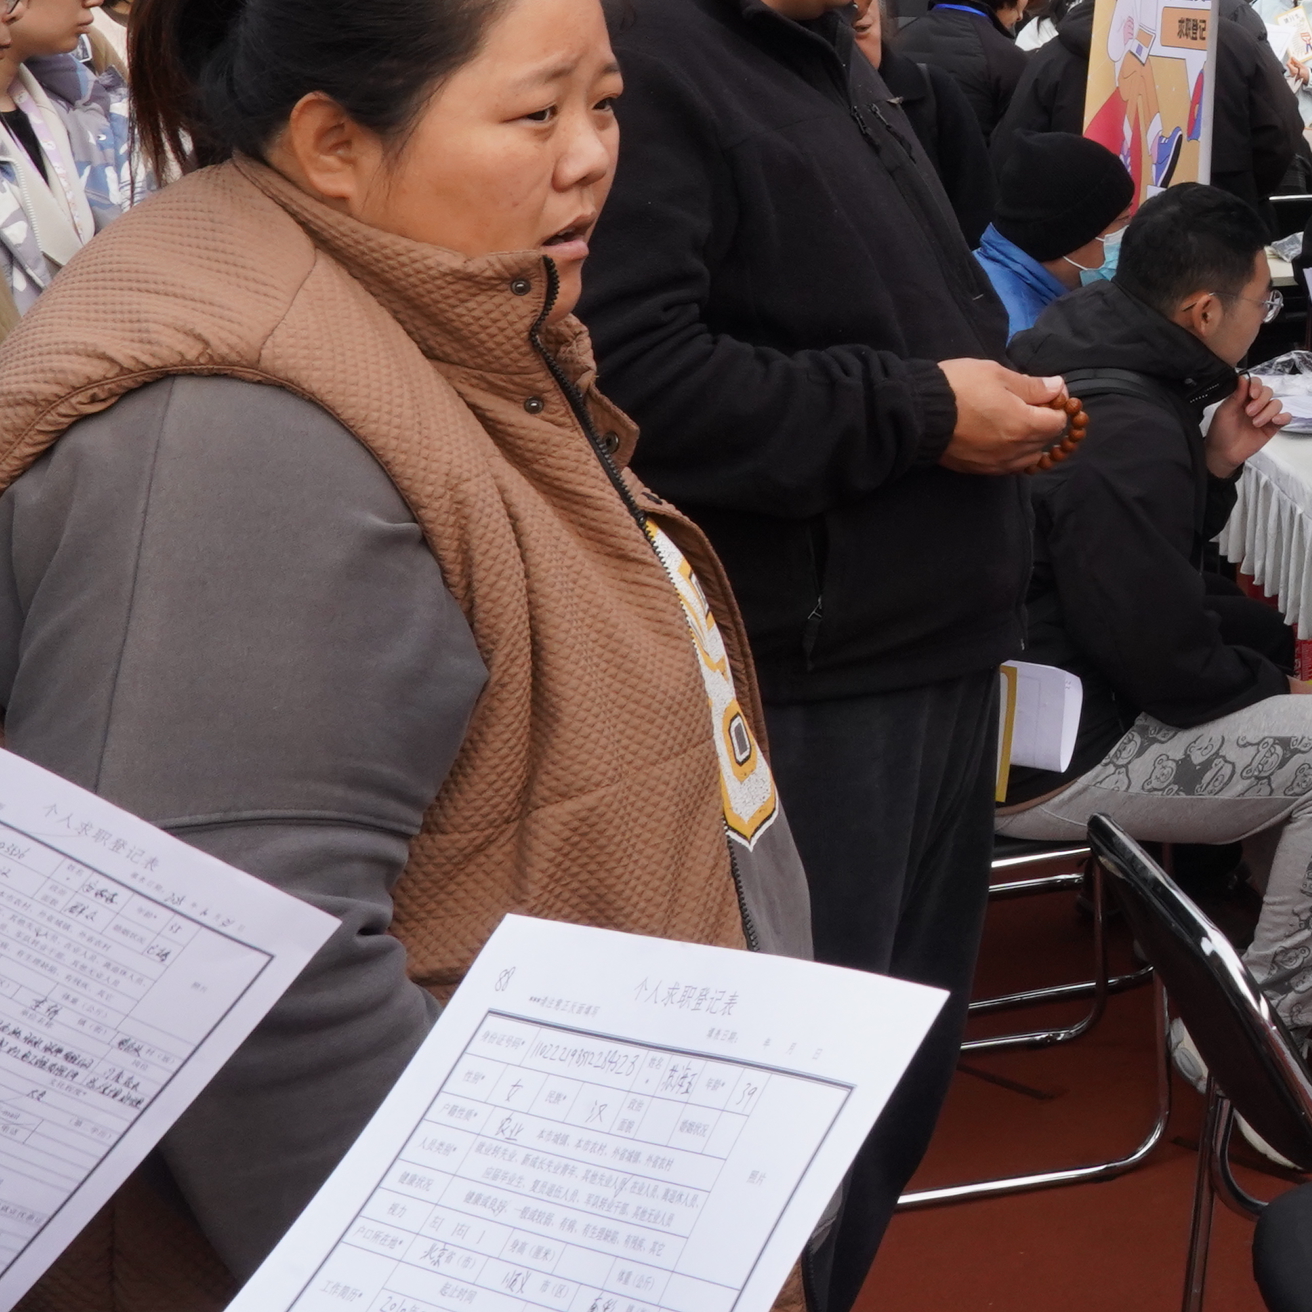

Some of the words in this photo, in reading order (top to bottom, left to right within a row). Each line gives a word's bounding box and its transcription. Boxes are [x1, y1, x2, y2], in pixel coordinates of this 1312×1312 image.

[1176, 16, 1207, 41] 求职登记
[43, 802, 160, 872] 个人求职登记表
[634, 976, 740, 1017] 个人求职登记表
